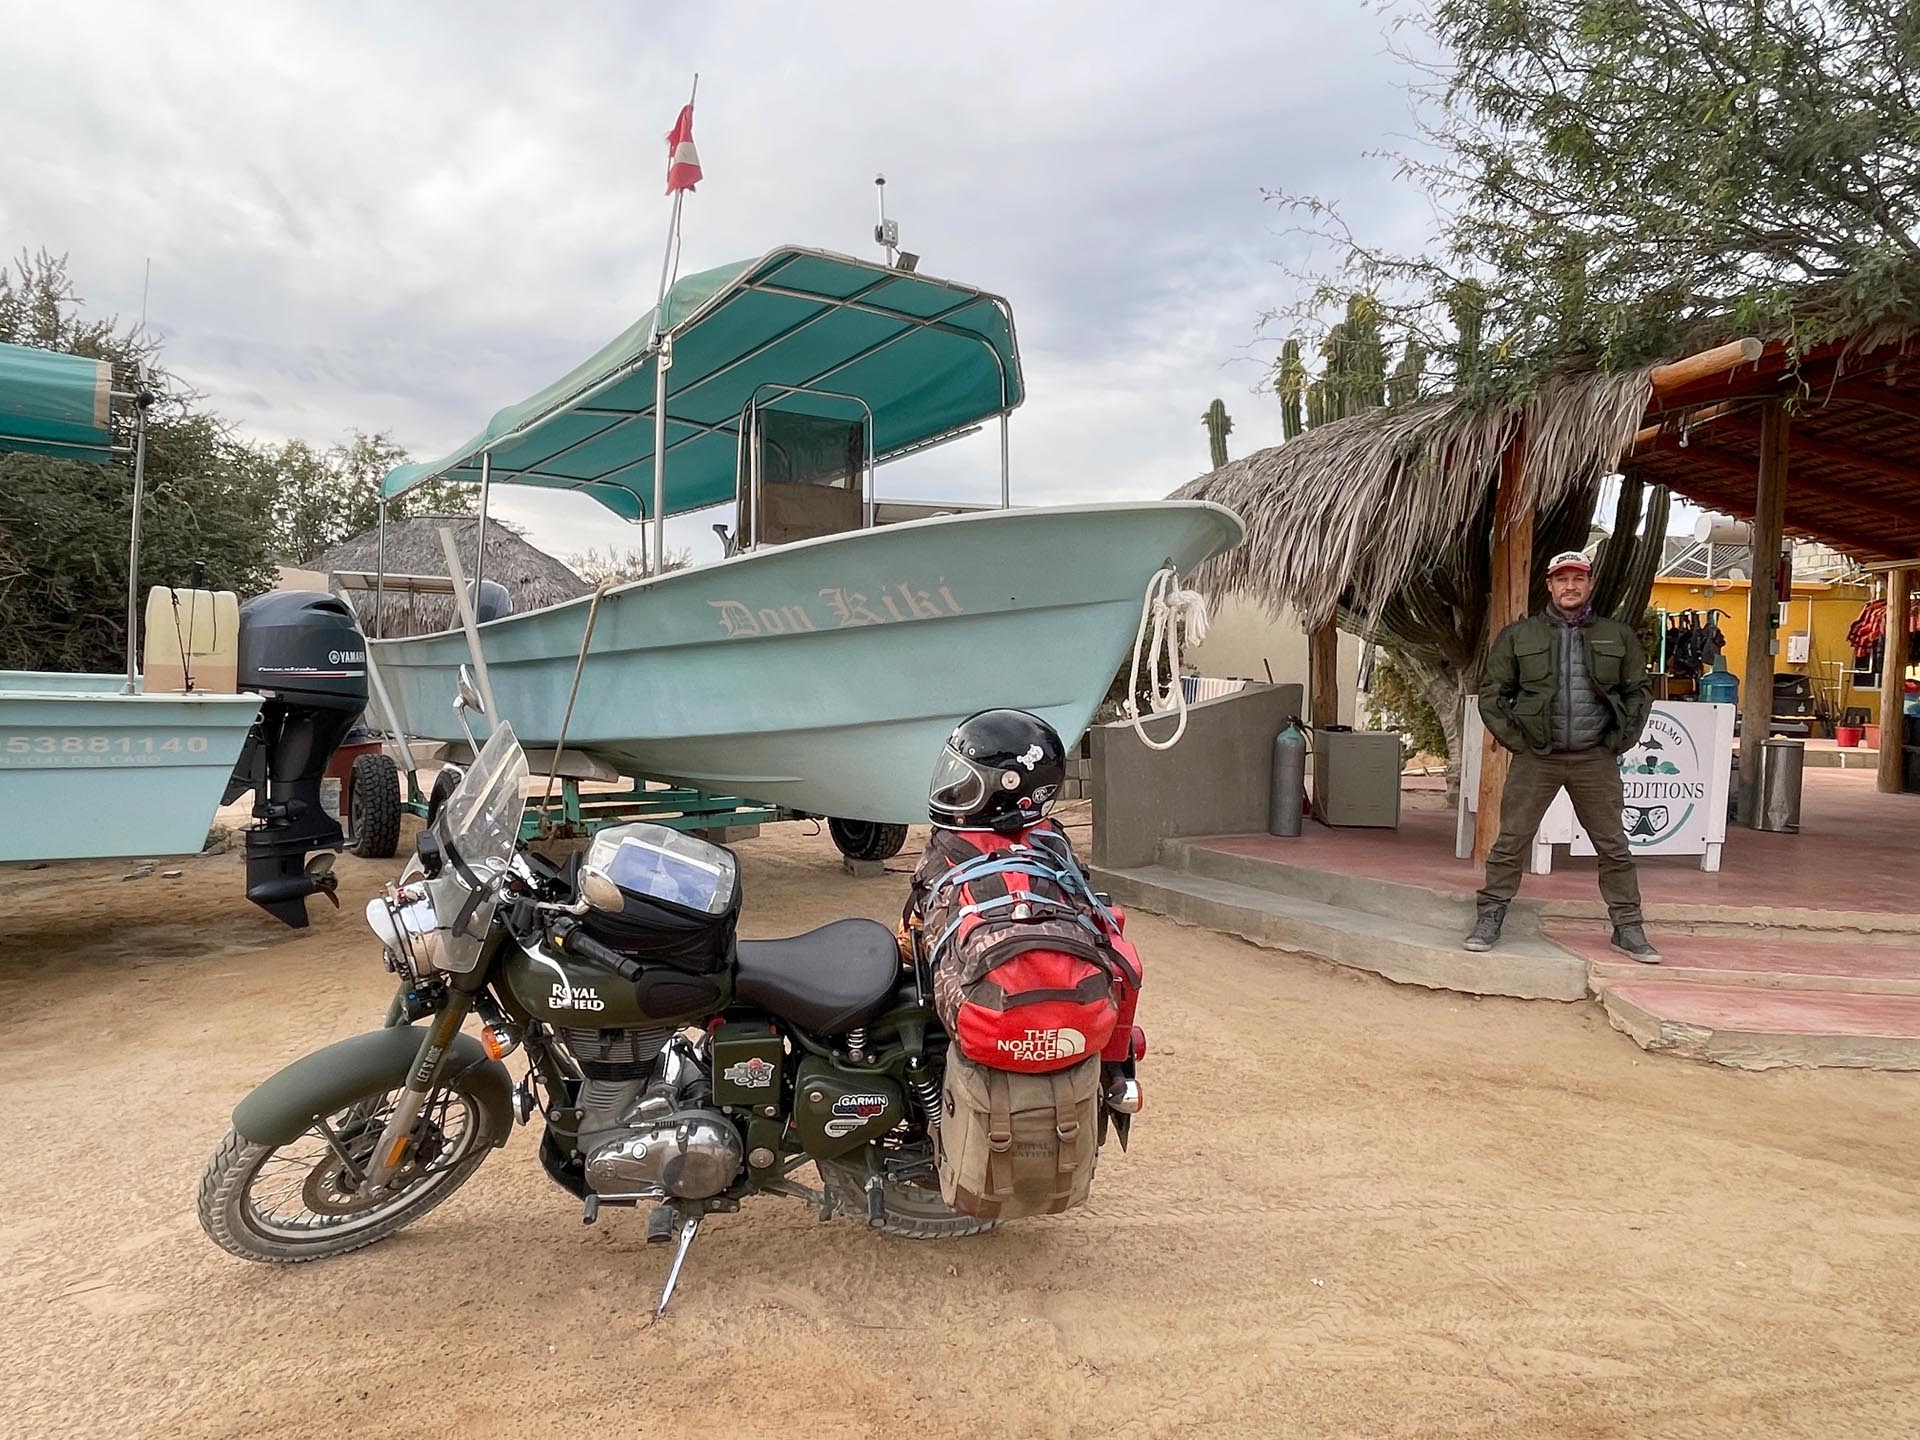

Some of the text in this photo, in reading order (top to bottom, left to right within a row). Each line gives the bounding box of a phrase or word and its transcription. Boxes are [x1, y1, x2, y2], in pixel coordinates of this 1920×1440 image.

[707, 576, 964, 639] Don Kiki
[340, 651, 365, 663] YAMAH
[1648, 720, 1682, 746] PULMO
[0, 736, 209, 753] 53881140
[1622, 782, 1705, 800] EDITIONS
[548, 996, 605, 1011] ENIELD
[1024, 1029, 1058, 1041] THE
[997, 1039, 1056, 1052] NORTH
[1013, 1050, 1056, 1061] FACE
[841, 1096, 886, 1106] GARMIN
